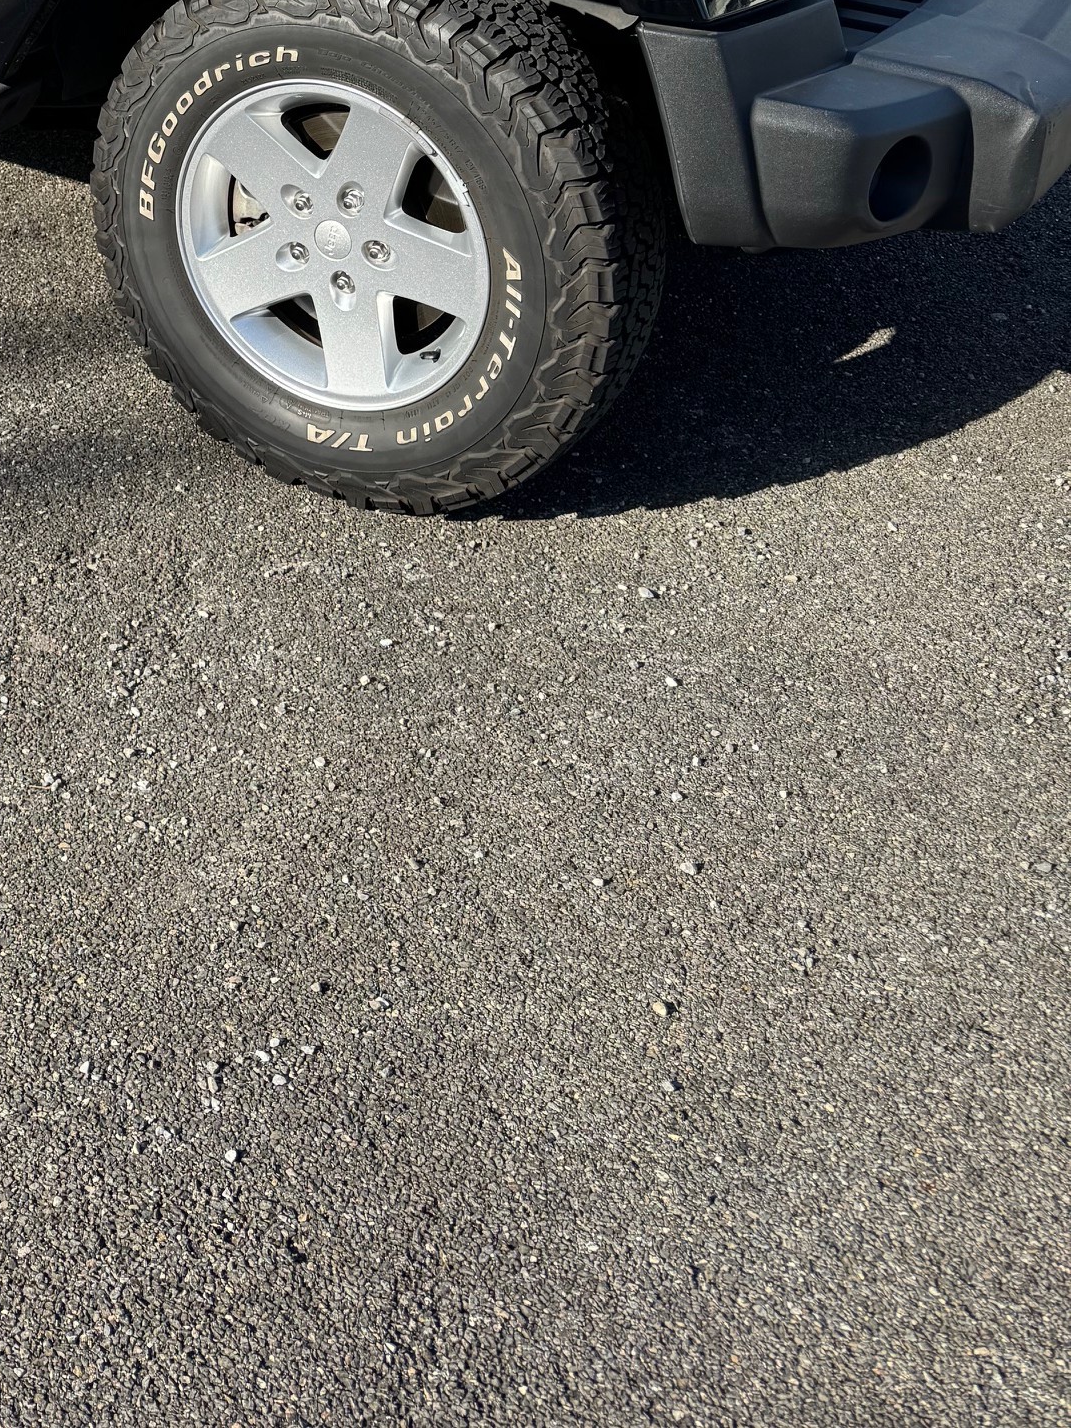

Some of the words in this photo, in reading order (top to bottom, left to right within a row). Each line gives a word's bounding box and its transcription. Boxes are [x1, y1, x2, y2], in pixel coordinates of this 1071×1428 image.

[139, 46, 299, 220] BFGoodrich
[395, 247, 522, 445] All-Terrain
[307, 423, 373, 452] T/A
